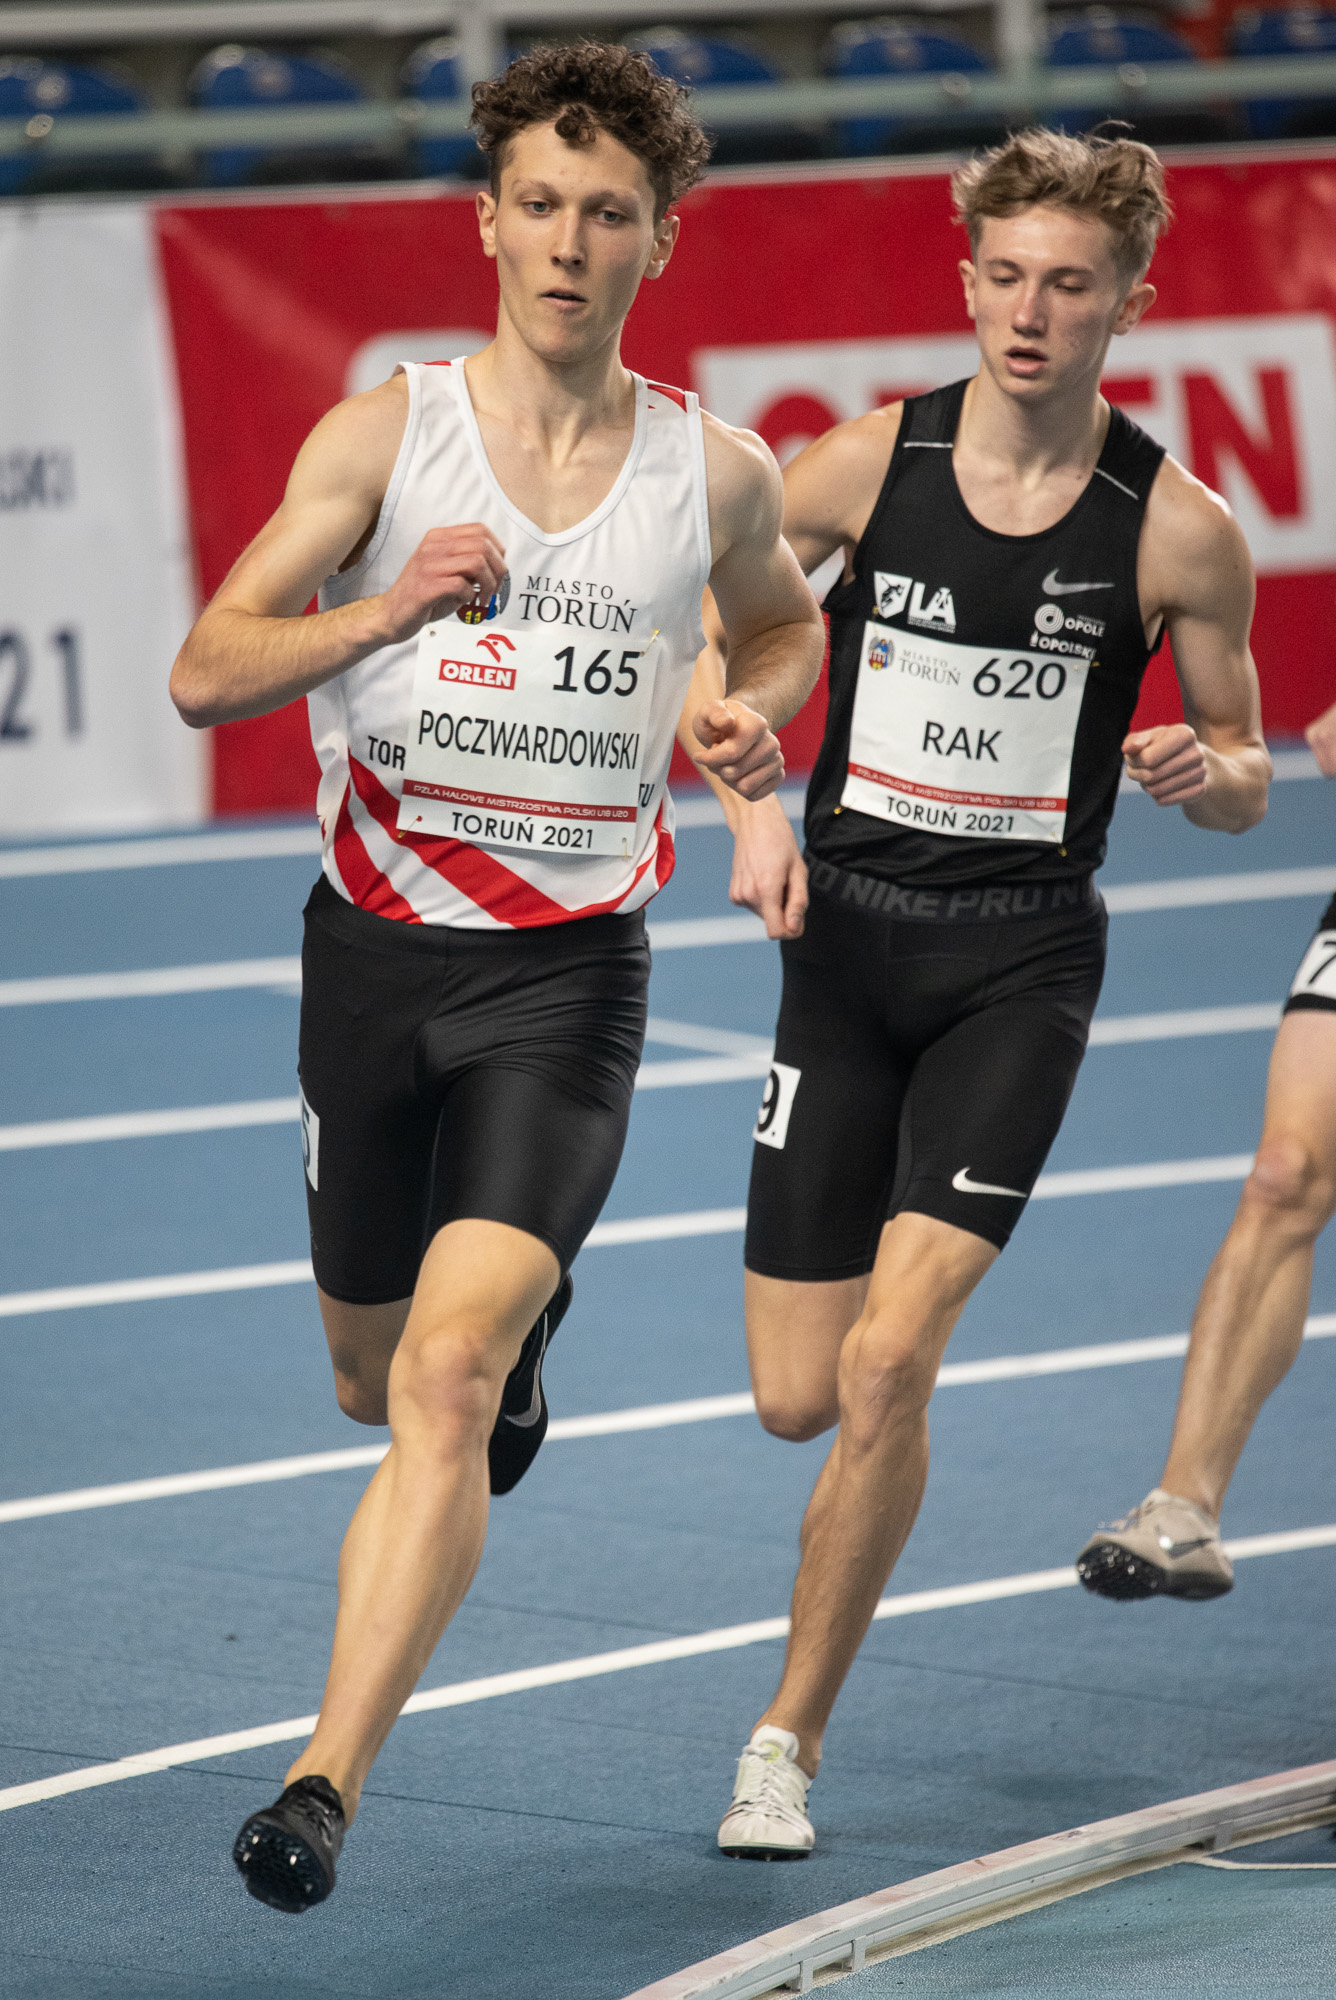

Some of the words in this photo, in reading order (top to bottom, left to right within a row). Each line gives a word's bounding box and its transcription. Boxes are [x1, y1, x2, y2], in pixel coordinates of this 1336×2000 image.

[526, 575, 614, 600] MIASTO
[519, 593, 637, 634] TORUŃ
[1064, 617, 1105, 637] OPOLE
[442, 661, 513, 689] ORLEN
[553, 646, 642, 697] 165
[903, 649, 949, 668] MIASTO
[898, 658, 962, 687] TORUŃ
[973, 658, 1067, 700] 620
[418, 709, 640, 770] POCZWARDOWSKI
[921, 720, 1003, 762] RAK
[413, 785, 440, 797] PZLA
[442, 790, 484, 804] HALOWE
[486, 797, 562, 814] MISTRZOSTWA
[563, 806, 596, 817] POLSKI
[887, 795, 957, 828] TORUŃ
[964, 813, 1015, 832] 2021
[452, 811, 534, 843] TORUŃ
[542, 825, 593, 849] 2021
[841, 872, 941, 918] NIKE
[947, 887, 1041, 918] PRO
